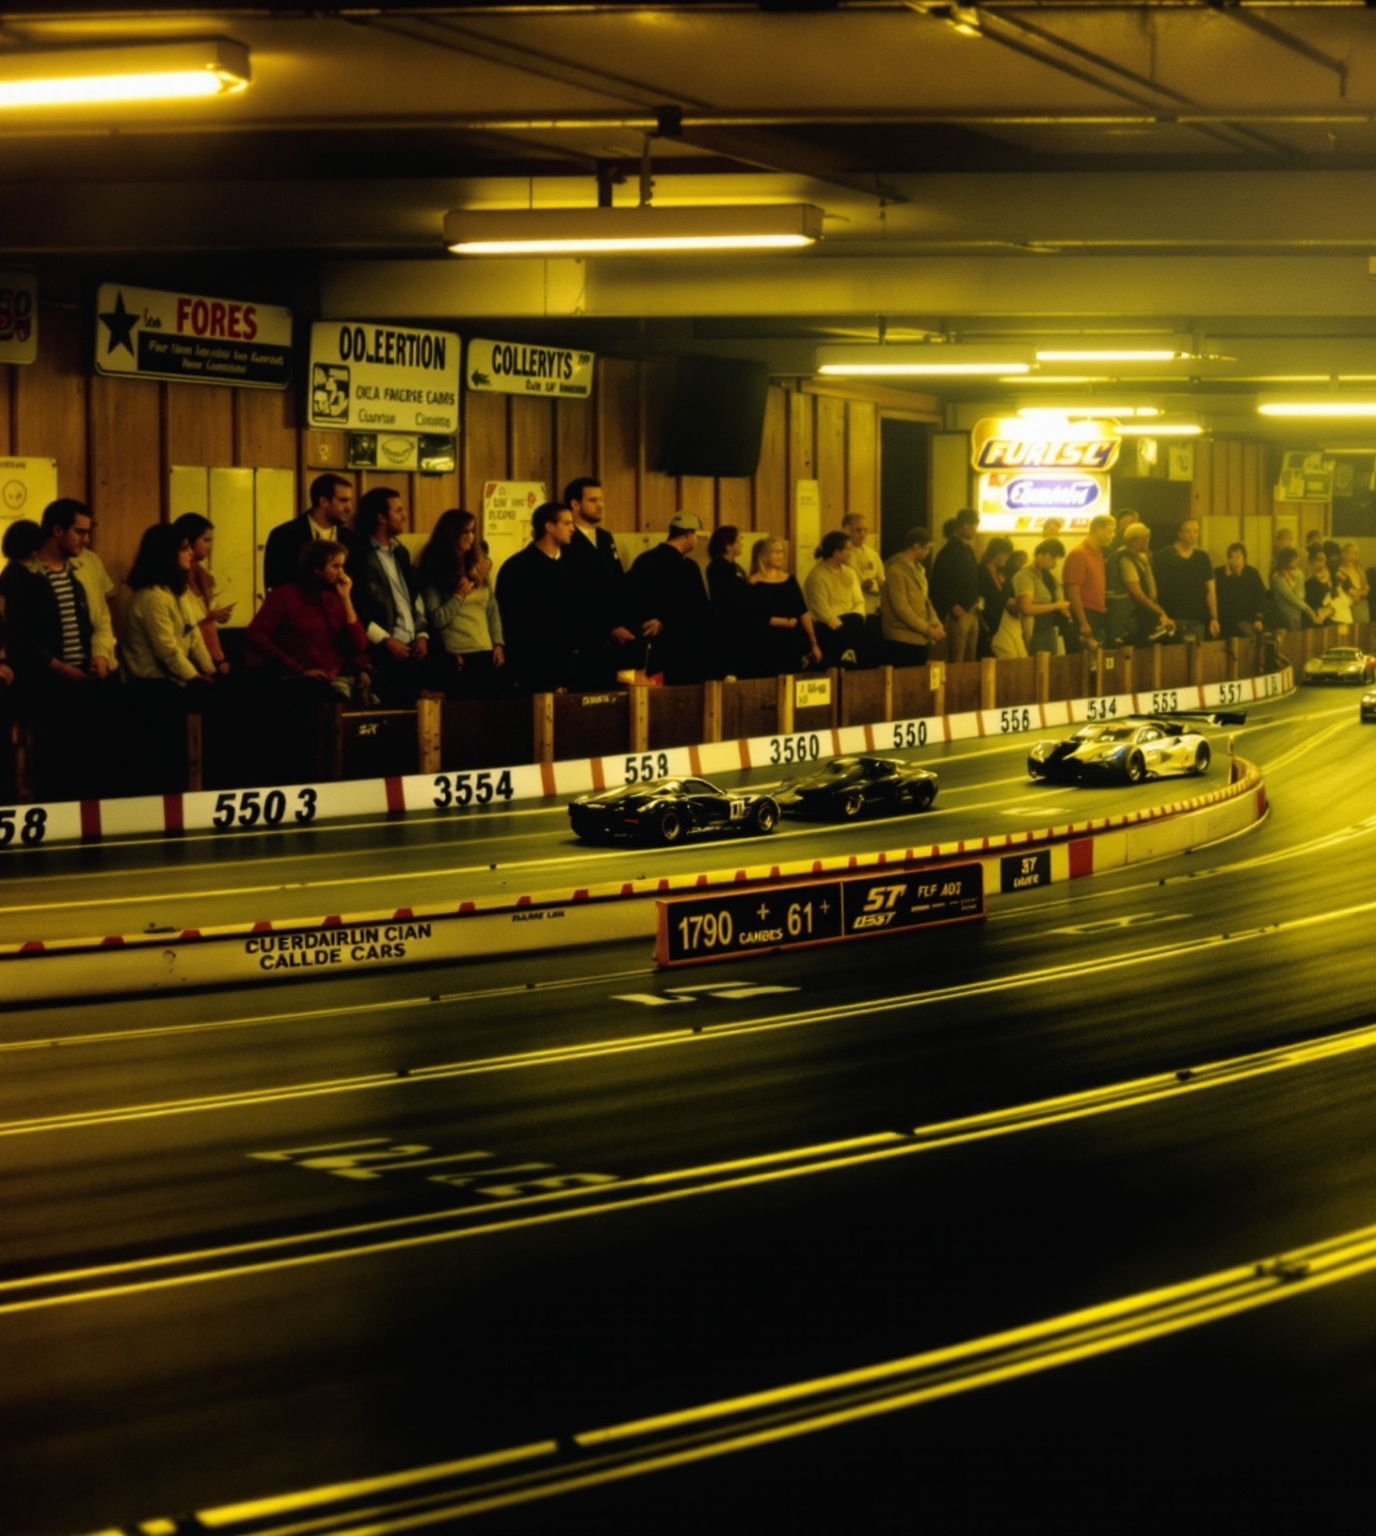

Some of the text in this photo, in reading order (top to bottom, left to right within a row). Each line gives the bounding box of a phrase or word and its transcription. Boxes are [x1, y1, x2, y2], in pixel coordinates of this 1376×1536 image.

[177, 297, 257, 340] FORES
[893, 721, 927, 748] 550
[1001, 708, 1030, 732] 556
[770, 734, 819, 764] 3560
[434, 770, 514, 807] 3554
[679, 910, 733, 951] 1790
[787, 903, 813, 936] 61
[260, 942, 406, 970] CALLDE CARS
